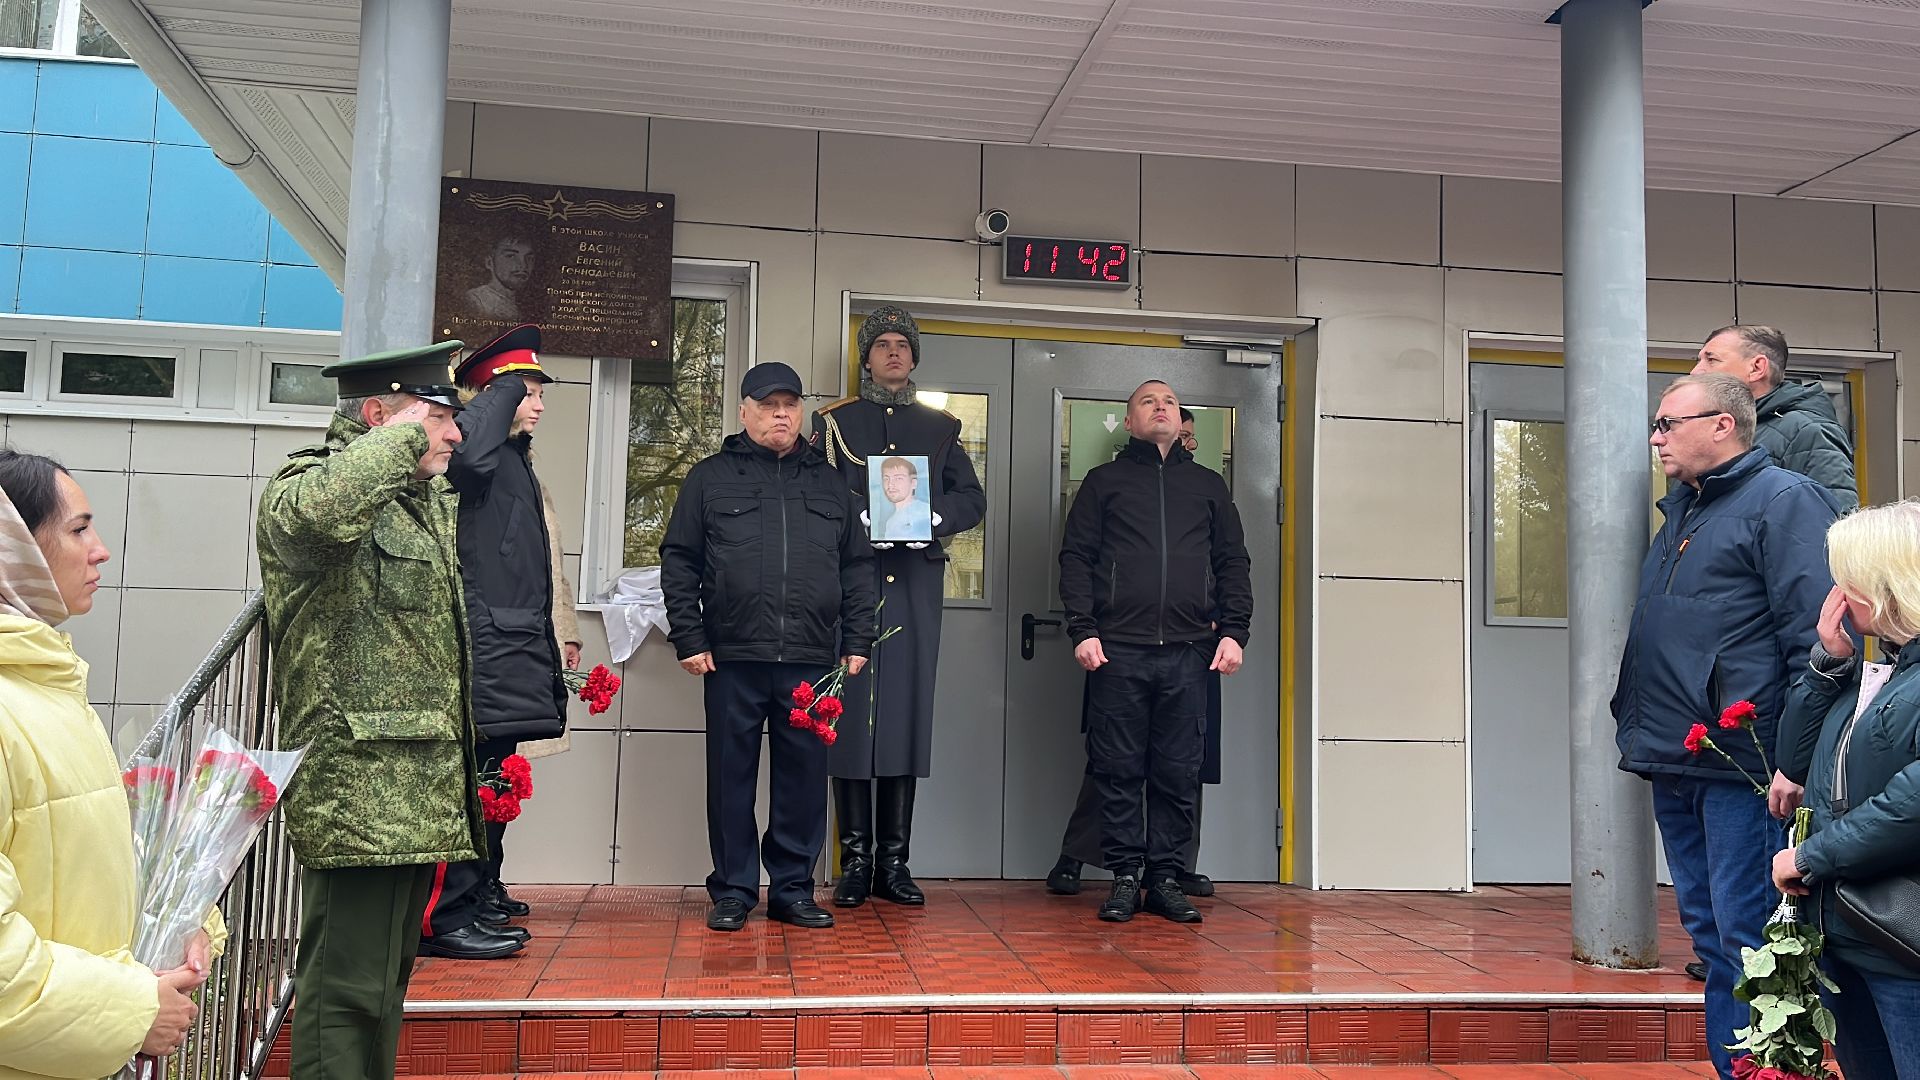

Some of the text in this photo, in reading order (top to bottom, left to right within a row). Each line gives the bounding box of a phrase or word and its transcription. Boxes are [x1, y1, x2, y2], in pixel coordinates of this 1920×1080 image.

[551, 225, 649, 240] В этой школе учился
[579, 241, 621, 254] ВАСИН
[576, 255, 623, 267] Евгений
[561, 265, 636, 279] Геннадьевич
[547, 287, 648, 301] Погиб при исполнении
[560, 298, 607, 306] воинского
[582, 306, 643, 316] Специальной
[592, 314, 639, 325] Операции
[559, 324, 601, 332] орденом
